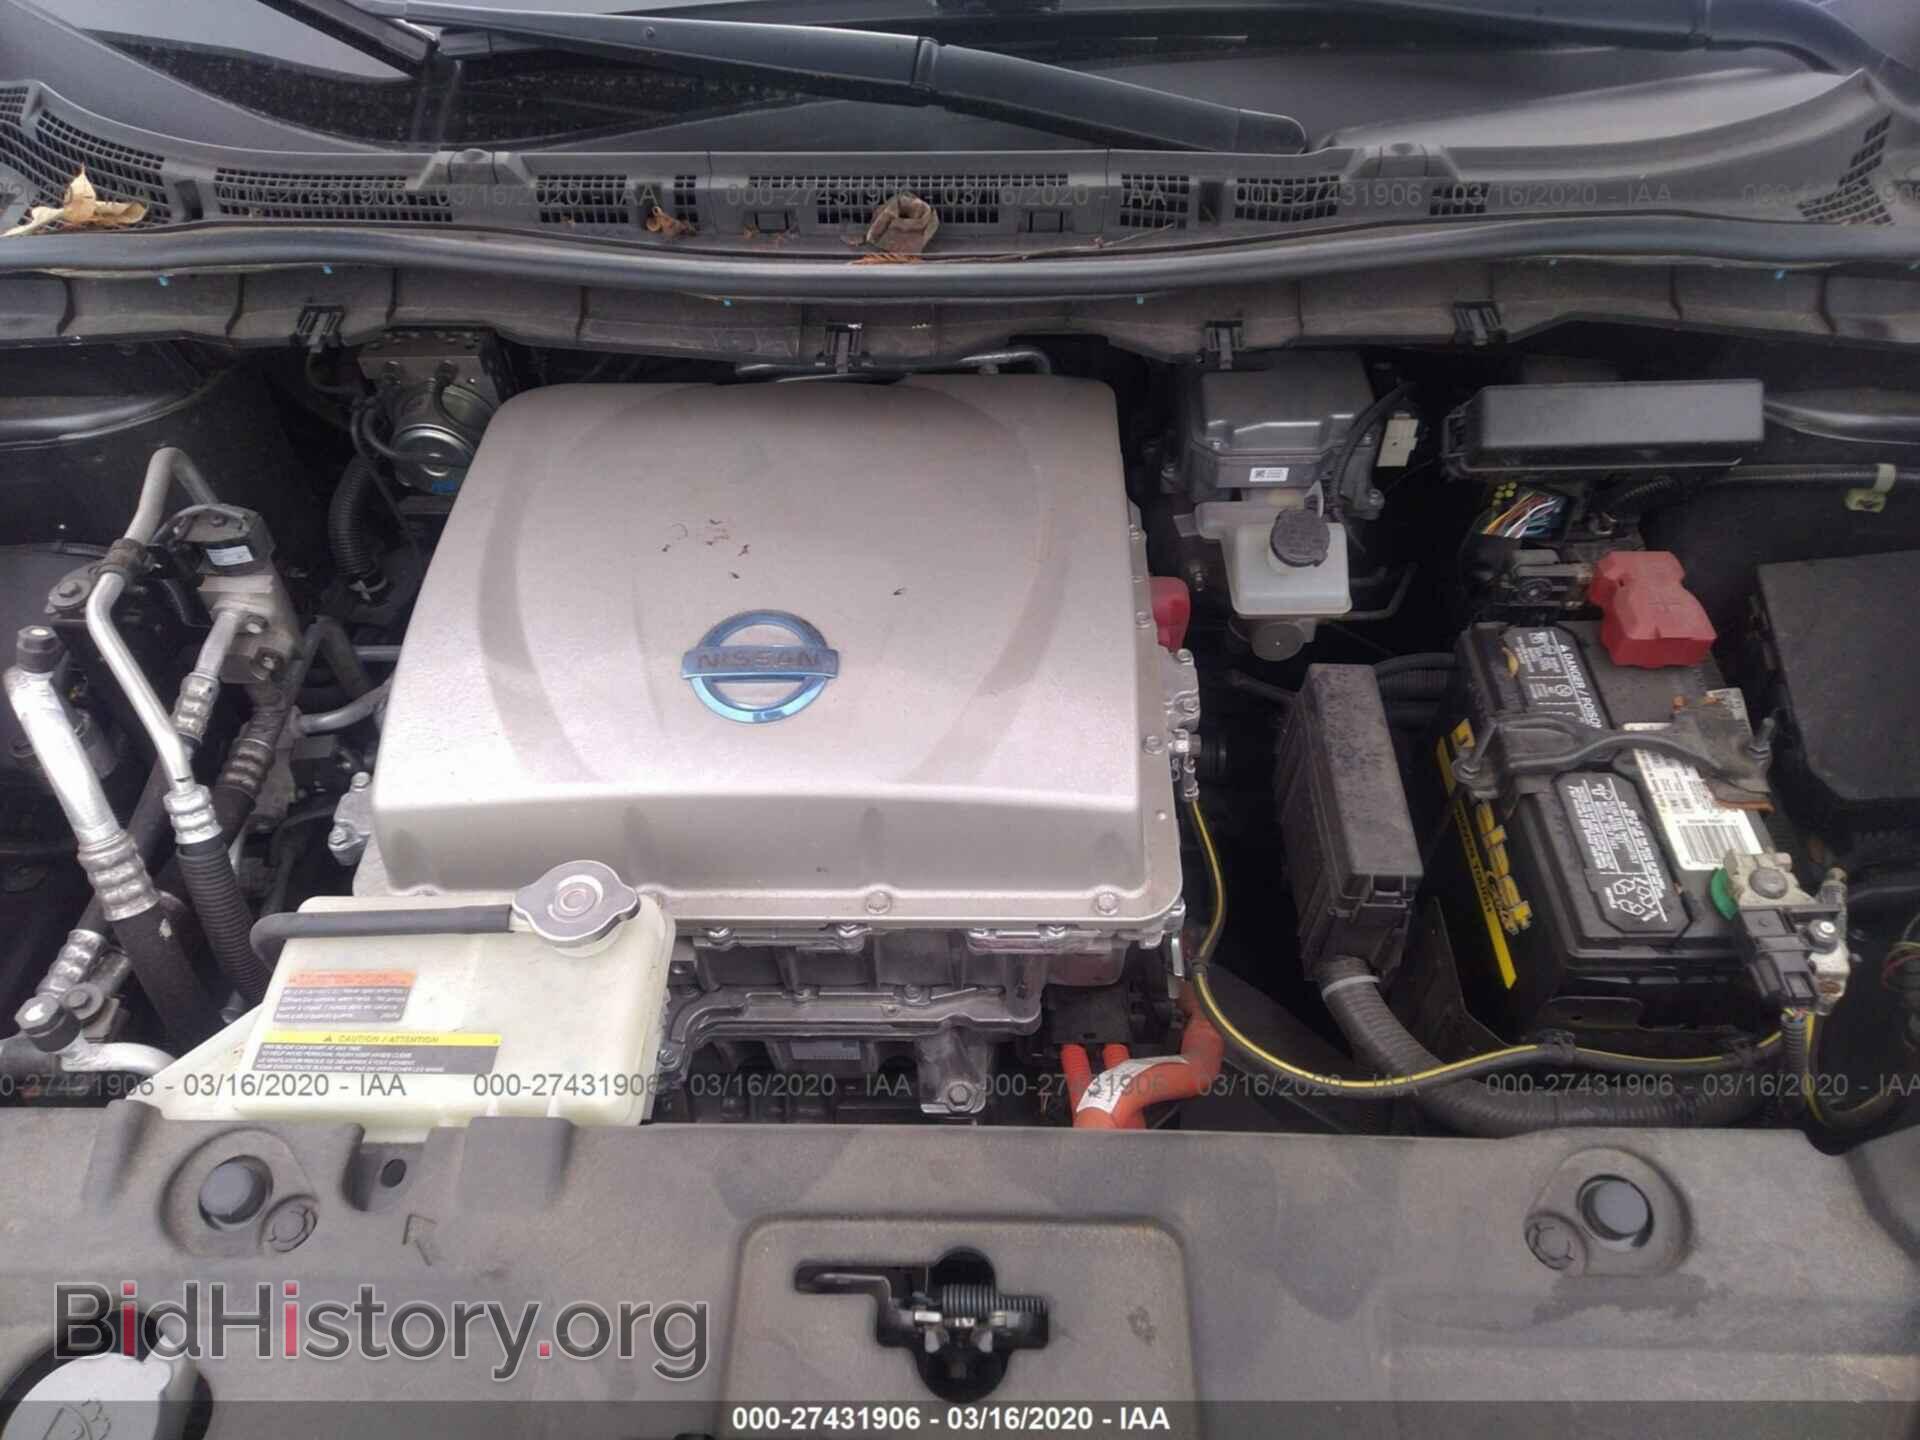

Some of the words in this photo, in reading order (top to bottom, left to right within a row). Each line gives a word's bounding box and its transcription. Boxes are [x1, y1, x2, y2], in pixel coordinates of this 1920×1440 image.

[697, 650, 819, 668] NISSAN
[1563, 653, 1587, 689] DANGER
[338, 1035, 378, 1043] CAUTION
[388, 1035, 440, 1044] ATTENTION
